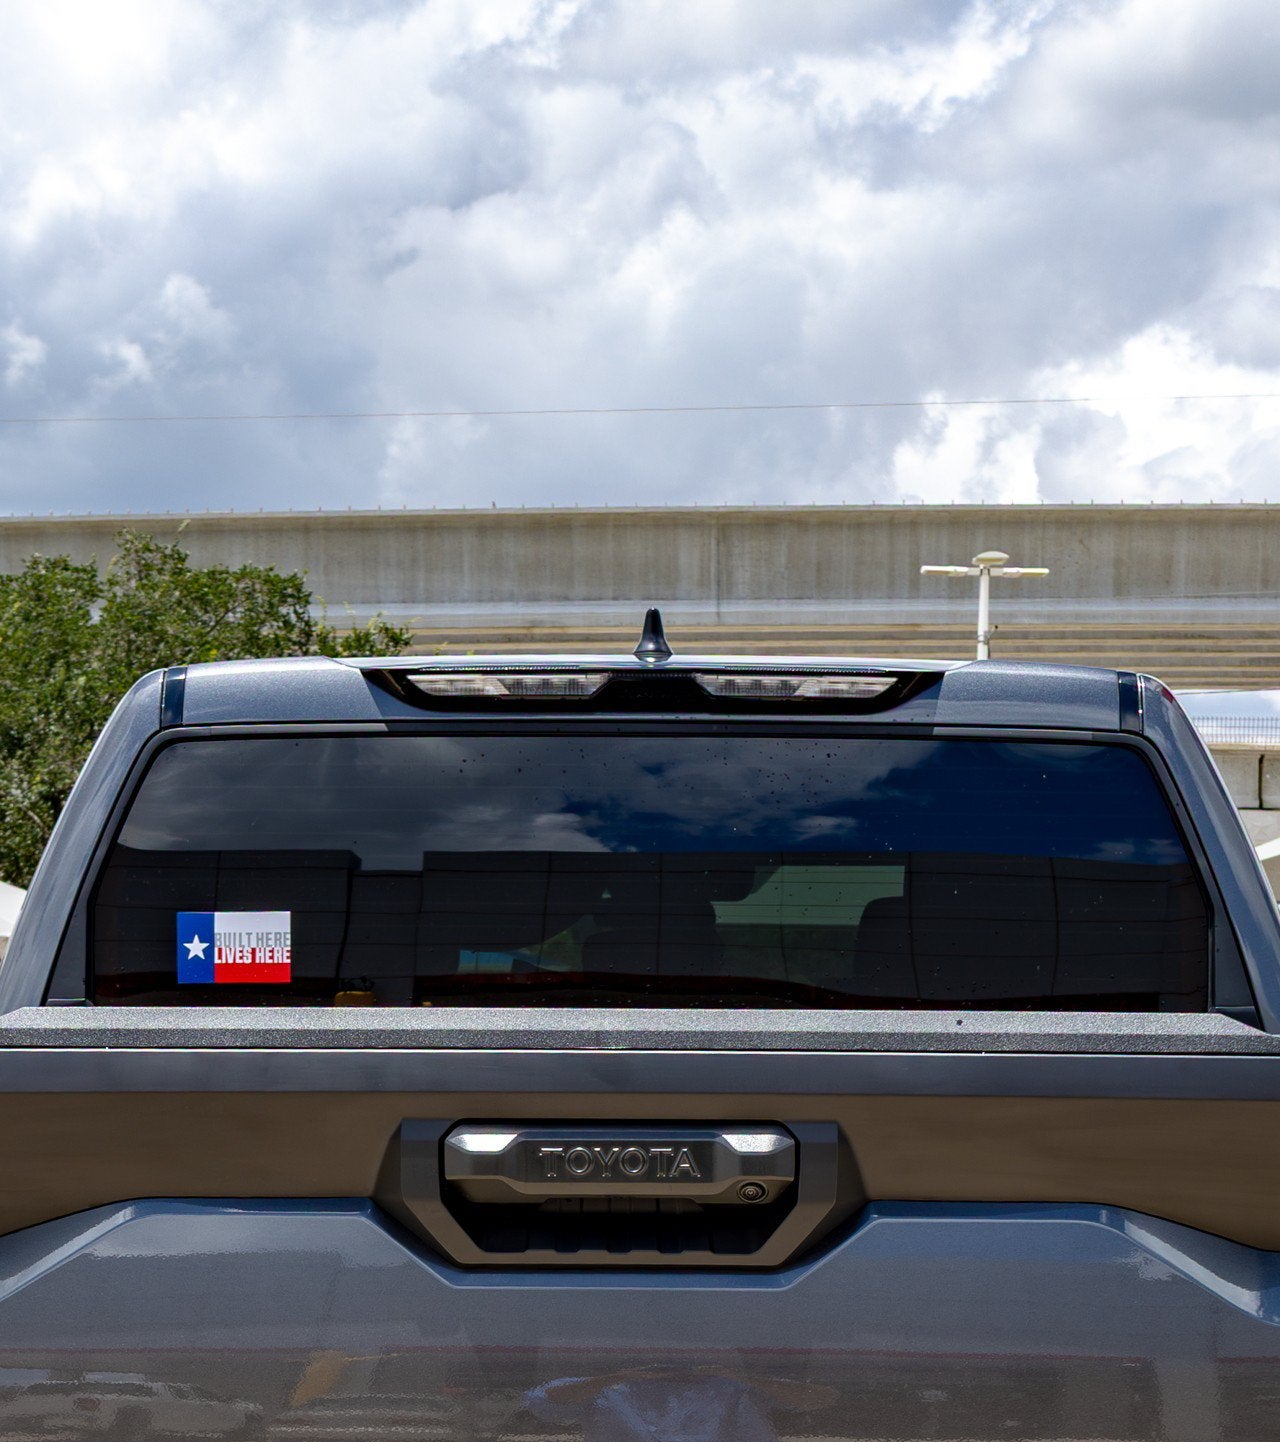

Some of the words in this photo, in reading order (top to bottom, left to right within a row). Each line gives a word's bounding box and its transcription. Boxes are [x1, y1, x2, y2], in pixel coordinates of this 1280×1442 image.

[214, 932, 253, 948] BUILT
[256, 931, 290, 947] HERE
[214, 947, 252, 964] LIVES
[255, 947, 291, 963] HERE
[539, 1146, 703, 1178] TOYOTA
